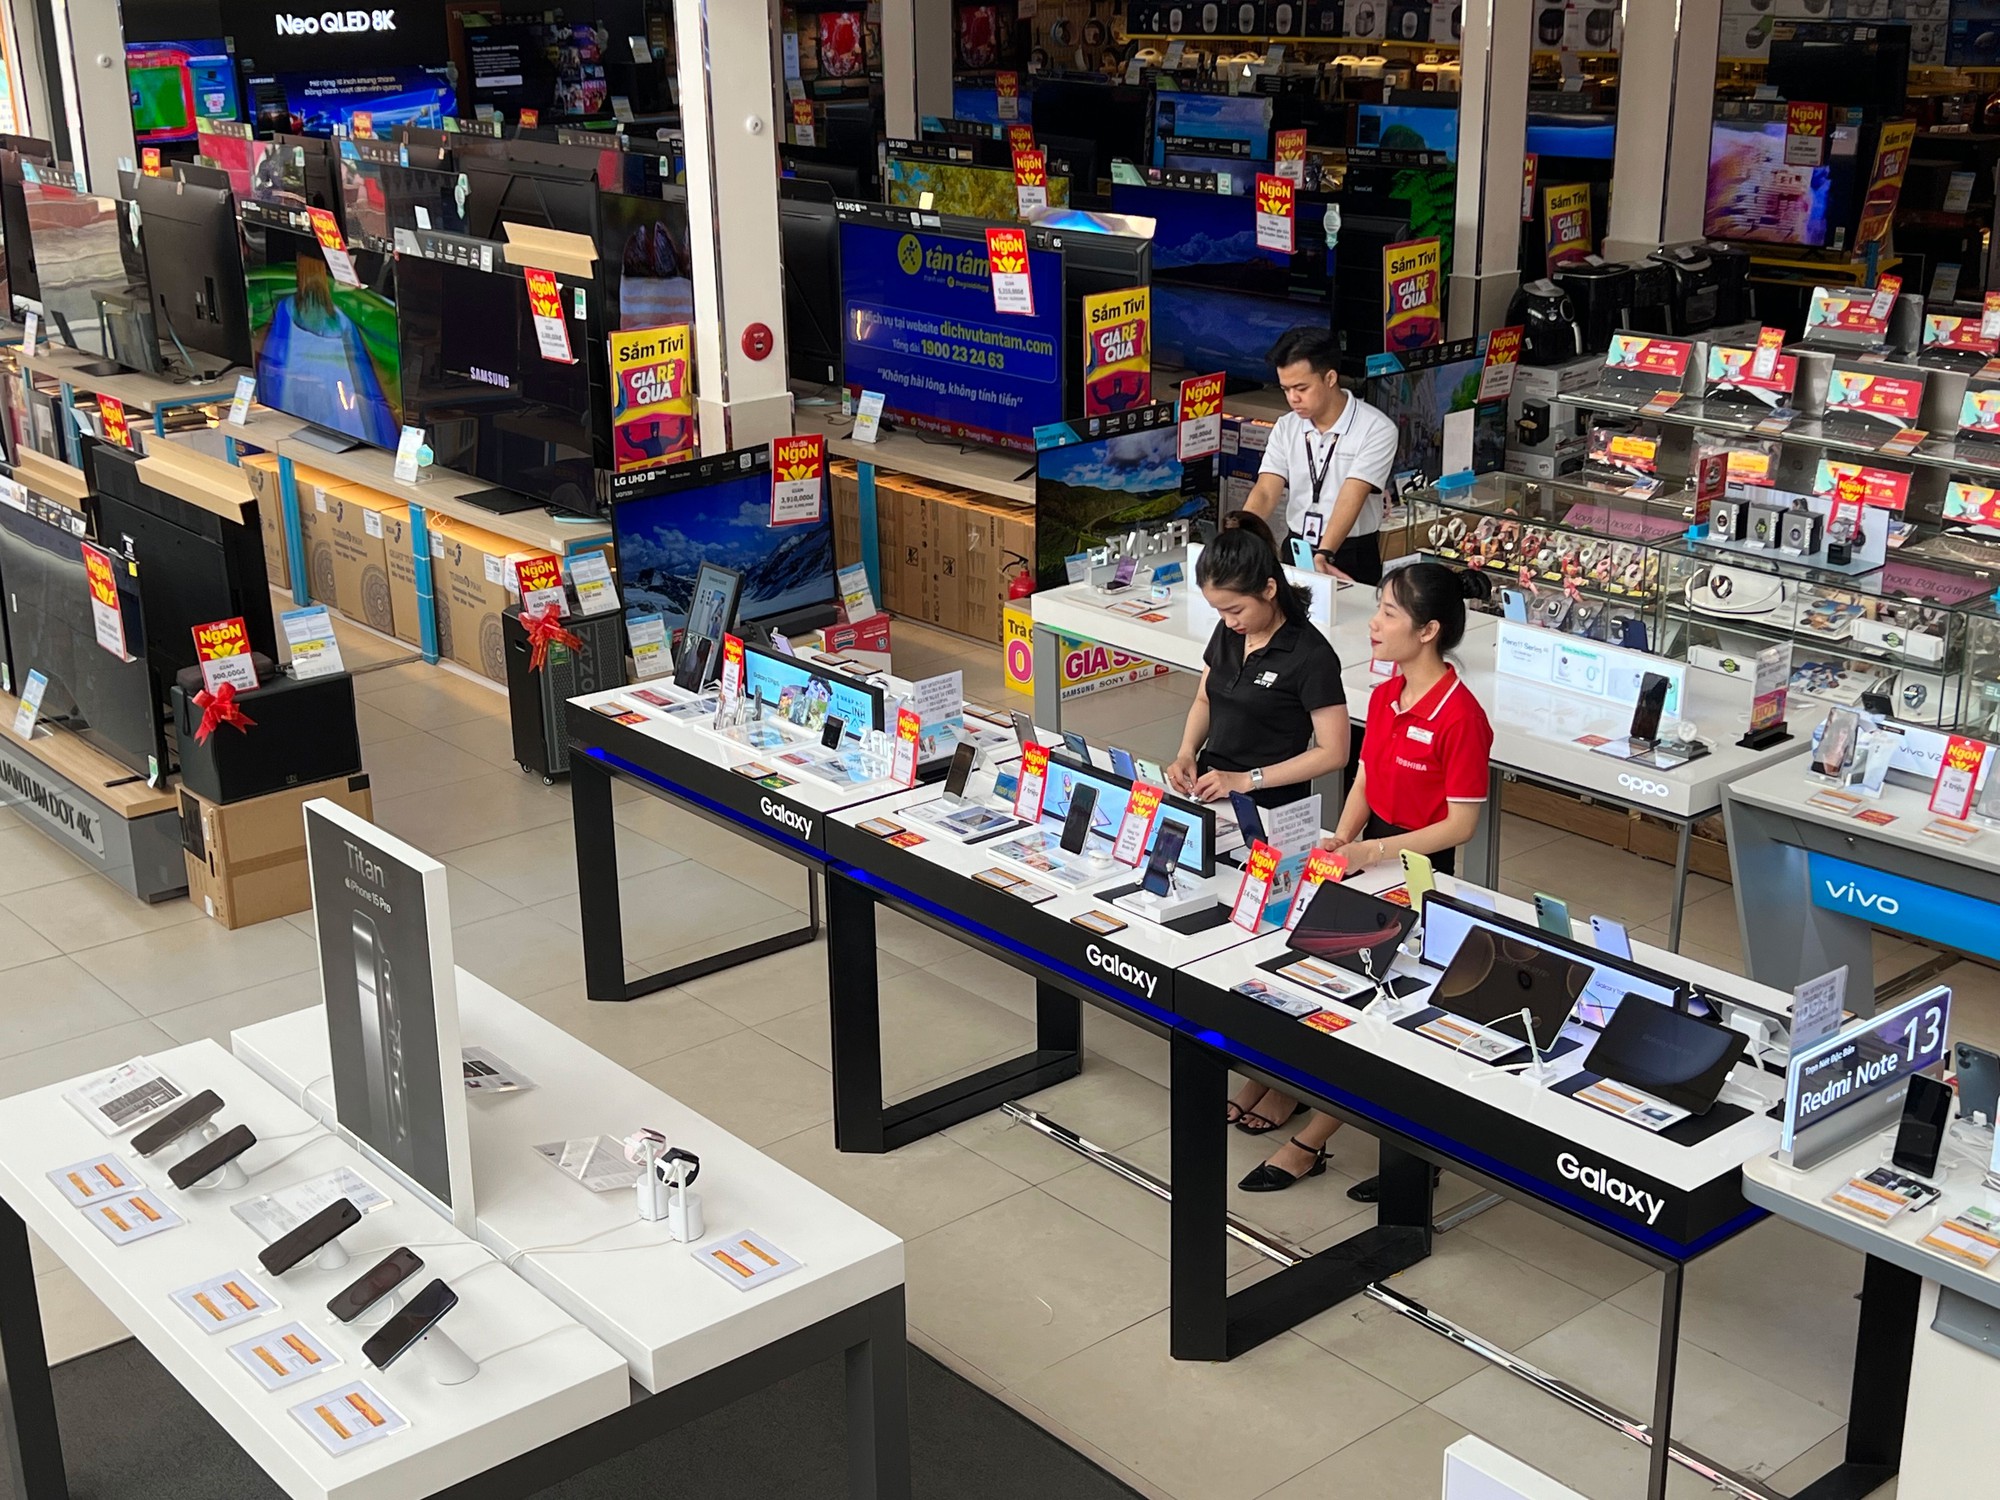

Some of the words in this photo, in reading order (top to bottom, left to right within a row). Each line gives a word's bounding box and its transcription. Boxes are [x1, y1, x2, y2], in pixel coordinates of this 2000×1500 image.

[275, 13, 318, 35] Neo
[320, 11, 369, 34] QLED
[371, 9, 397, 31] 8K
[925, 246, 956, 275] tận
[958, 249, 989, 277] tâm
[1390, 257, 1417, 276] Sắm
[1091, 302, 1121, 323] Sắm
[883, 315, 893, 329] vụ
[894, 315, 905, 330] tại
[905, 319, 939, 336] website
[939, 321, 1053, 356] dichvutantam.com
[618, 340, 656, 363] Sắm
[921, 338, 950, 359] 1900
[952, 345, 968, 362] 23
[969, 348, 986, 366] 24
[987, 350, 1004, 370] 63
[470, 366, 510, 389] SAMSUNG
[910, 374, 925, 387] hài
[926, 379, 947, 396] lòng,
[947, 383, 977, 402] không
[977, 387, 996, 403] tính
[778, 443, 819, 464] NgoN
[614, 476, 627, 487] LG
[627, 474, 647, 484] UHD
[1769, 511, 1779, 542] GARMIN
[1803, 517, 1814, 549] GARMIN
[519, 562, 555, 579] NgoN
[198, 623, 243, 646] NgoN
[1007, 619, 1027, 638] Trả
[1062, 683, 1095, 699] SAMSUNG
[1099, 676, 1125, 688] SONY
[1138, 669, 1149, 678] LG
[1754, 702, 1777, 721] HOT
[1395, 755, 1427, 772] TOSHIBA
[1901, 744, 1925, 758] vivo
[1927, 751, 1942, 762] V2
[1948, 743, 1982, 763] NgoN
[1617, 773, 1669, 797] oppo
[1942, 779, 1949, 790] 2
[1949, 780, 1966, 794] triệu
[0, 759, 50, 812] UANTUM
[49, 791, 75, 830] DOT
[77, 811, 95, 844] 4K
[1131, 791, 1158, 808] NgoN
[760, 796, 813, 840] Galaxy
[343, 840, 386, 889] Titan
[1252, 851, 1276, 872] NgoN
[1308, 856, 1343, 877] NgoN
[350, 879, 372, 901] iPhone
[371, 893, 380, 907] 15
[379, 897, 392, 914] Pro
[1825, 880, 1899, 915] vivo
[1086, 943, 1158, 999] Galaxy
[1595, 980, 1617, 994] Galaxy
[1799, 1072, 1853, 1117] Redmi
[1854, 1053, 1898, 1089] Note
[1903, 1005, 1943, 1062] 13
[1556, 1152, 1665, 1226] Galaxy
